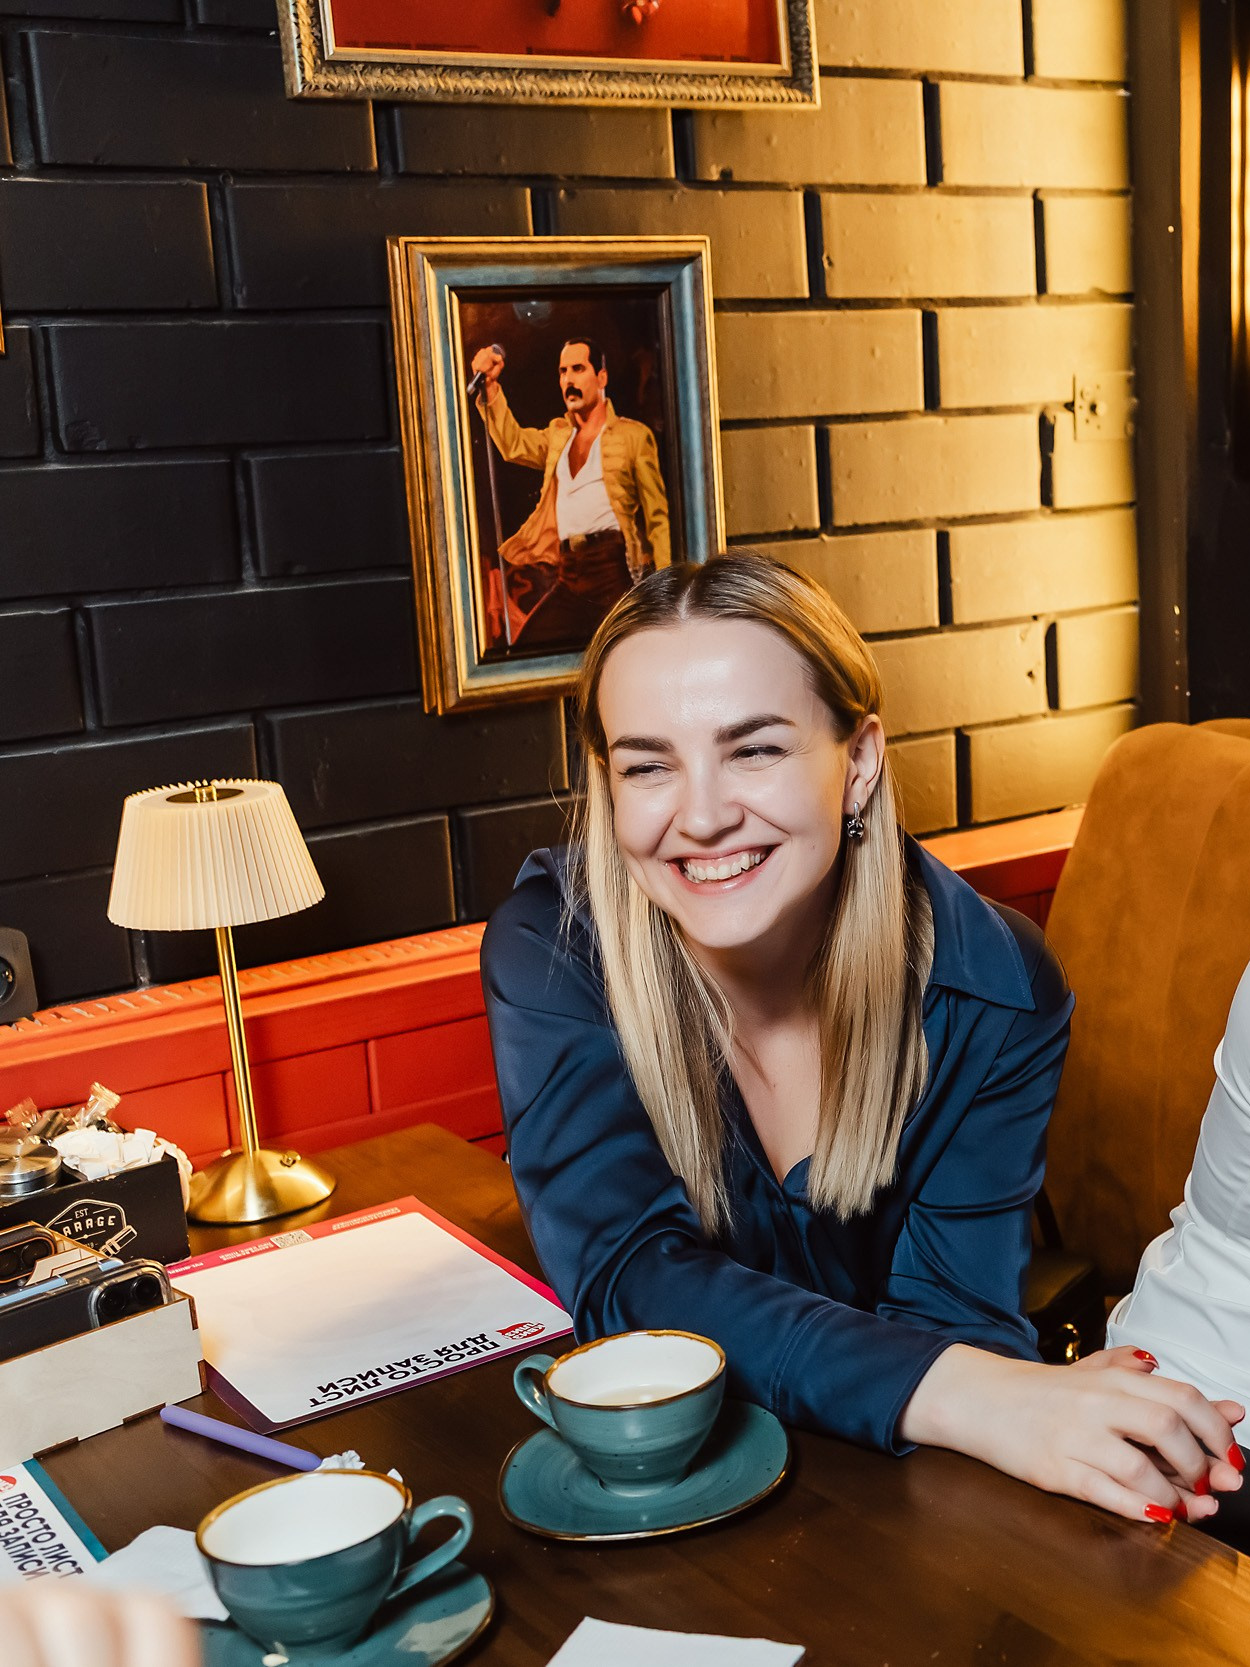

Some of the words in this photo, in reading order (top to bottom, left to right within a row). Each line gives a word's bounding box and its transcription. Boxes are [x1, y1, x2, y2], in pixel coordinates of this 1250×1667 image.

[62, 1215, 117, 1237] ARAGE
[75, 1208, 88, 1219] EST
[388, 1341, 501, 1381] ПРОСТО
[432, 1333, 490, 1356] ДЛЯ
[316, 1353, 428, 1394] ЗАПИСИ
[309, 1377, 382, 1407] ЛИСТ
[3, 1492, 57, 1544] ПРОСТО
[38, 1543, 84, 1579] ЛИСТ
[0, 1527, 50, 1581] ЗАПИСИ
